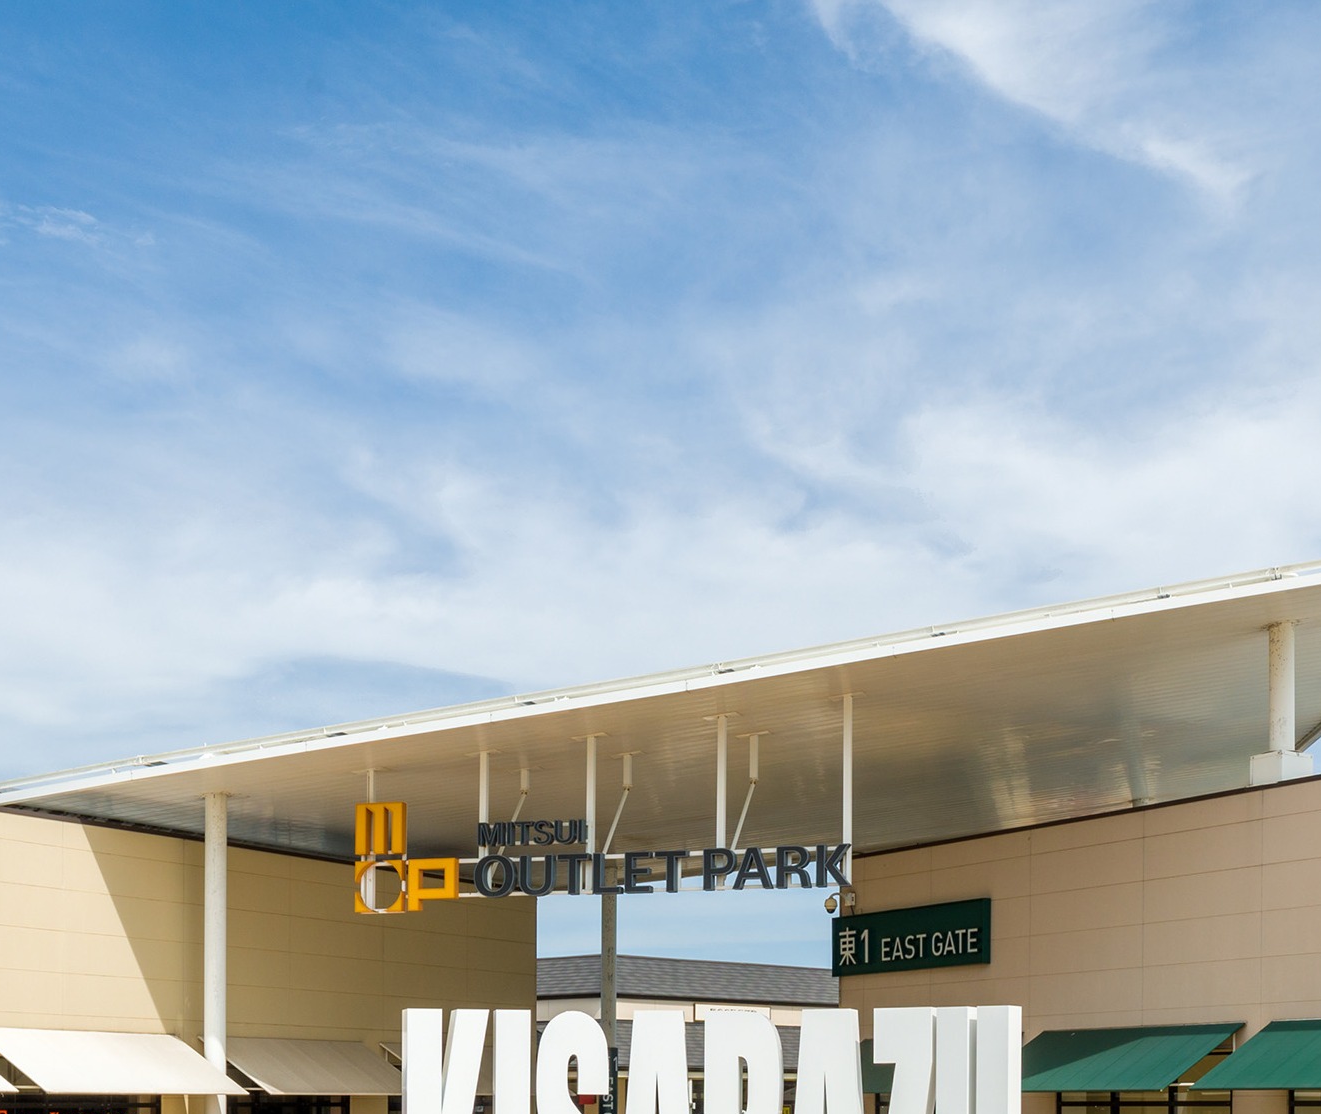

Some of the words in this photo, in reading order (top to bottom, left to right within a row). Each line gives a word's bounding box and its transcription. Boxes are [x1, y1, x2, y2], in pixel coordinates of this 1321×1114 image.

[479, 819, 588, 846] MITSUI
[474, 850, 689, 898] OUTLET
[702, 843, 852, 892] PARK
[881, 933, 927, 962] EAST
[932, 927, 979, 957] GATE
